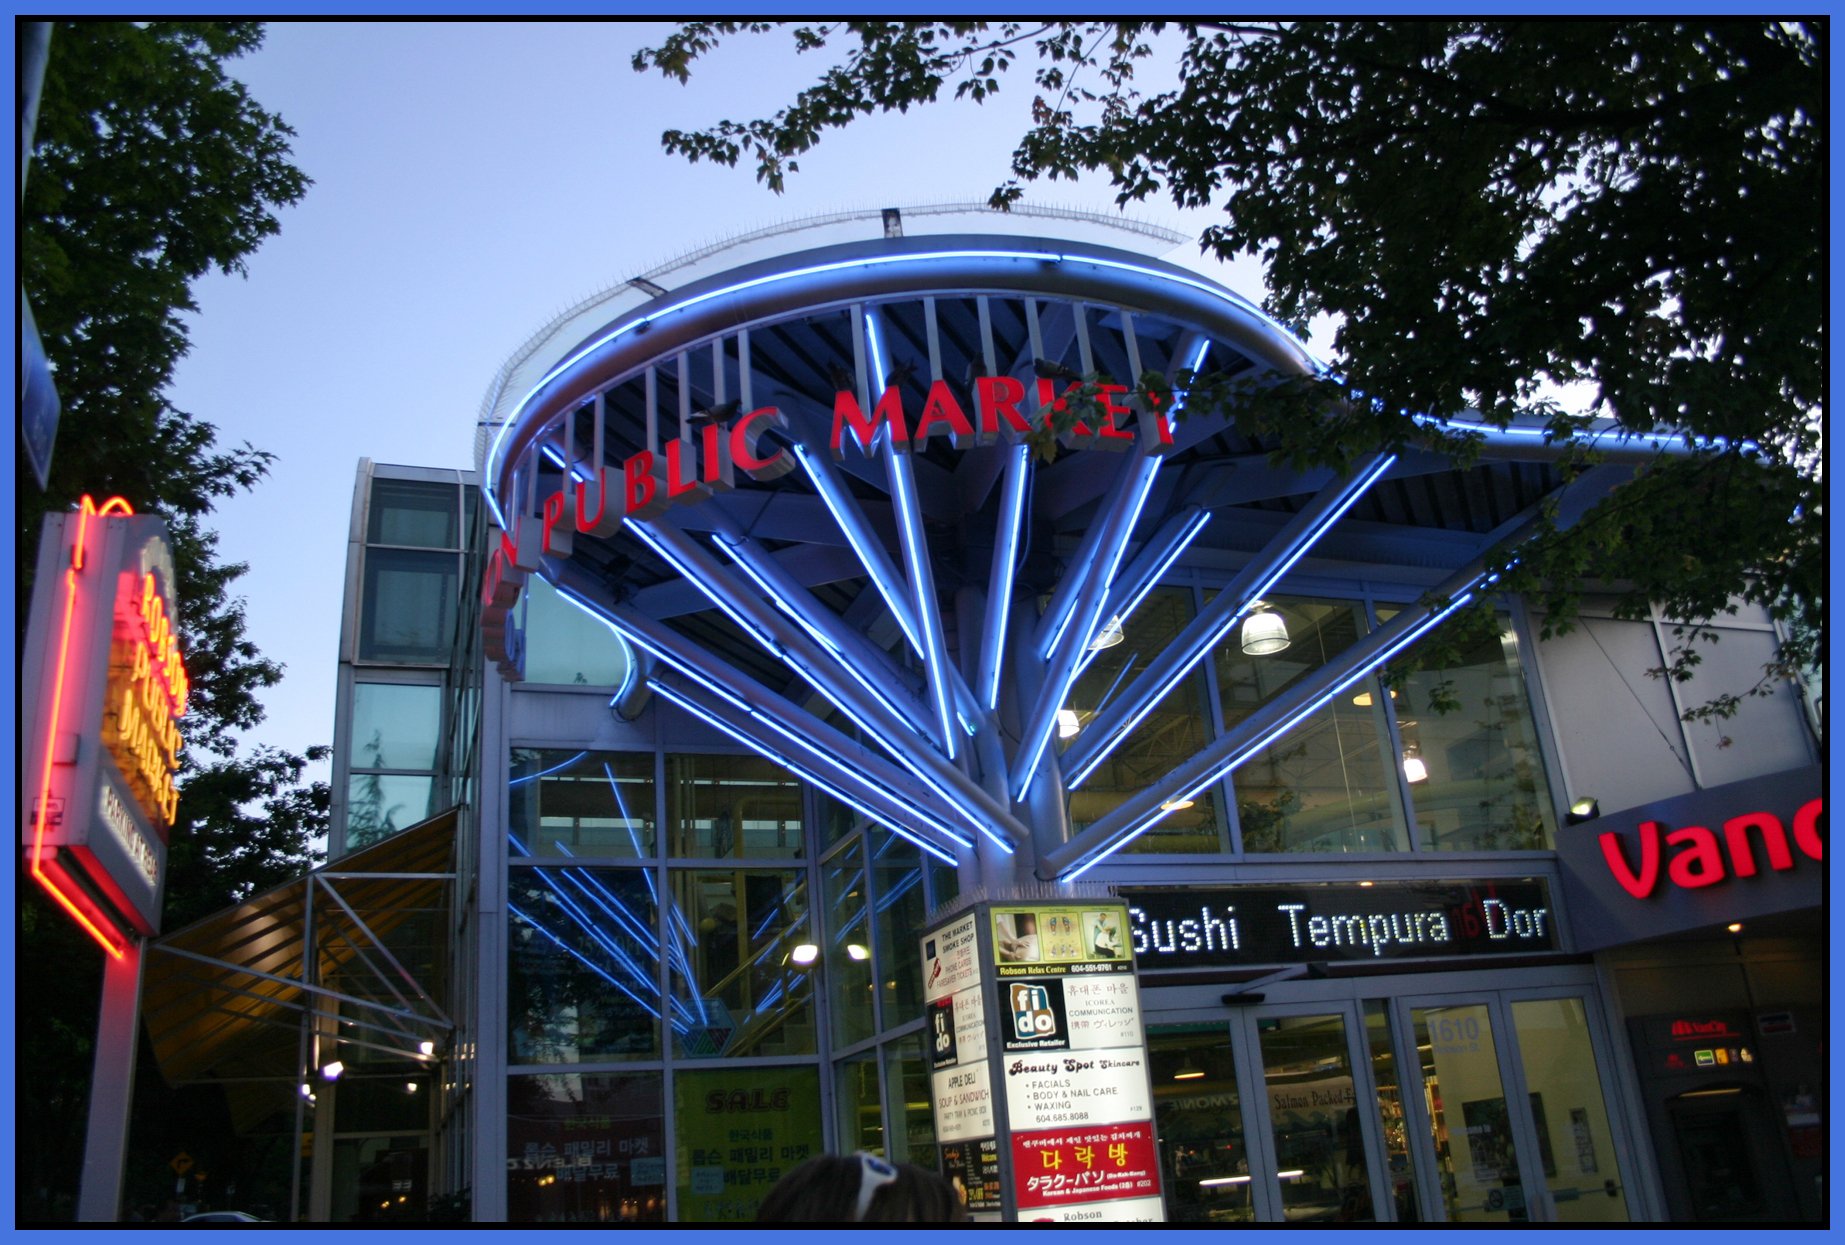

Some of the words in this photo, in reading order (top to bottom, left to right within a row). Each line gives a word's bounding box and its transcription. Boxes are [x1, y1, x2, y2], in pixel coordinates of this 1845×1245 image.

[542, 405, 792, 557] PUBLIC
[133, 641, 182, 769] PUBLIC
[119, 689, 178, 827] MARKET
[942, 932, 952, 943] THE
[952, 920, 974, 936] MARKET
[1129, 904, 1240, 954] Sushi
[1277, 903, 1451, 957] Tempura
[1482, 899, 1549, 939] Dor
[943, 940, 960, 954] SMOKE
[960, 932, 975, 945] SHOP
[1000, 966, 1027, 976] Robson
[1028, 966, 1045, 975] Relax
[1045, 965, 1067, 974] Centre
[1067, 983, 1102, 996] 휴대폰
[1106, 982, 1129, 995] 마을
[1068, 1007, 1134, 1017] COMMUNICATION
[1429, 1016, 1480, 1042] 1610
[1007, 1040, 1039, 1049] Exclusive
[1039, 1039, 1066, 1048] Retailer
[1009, 1059, 1059, 1077] Beauty
[1062, 1058, 1095, 1073] Spot
[1098, 1059, 1141, 1070] Skincare
[948, 1075, 963, 1090] APPLE
[964, 1071, 976, 1086] DELI
[1031, 1079, 1072, 1089] FACIALS
[705, 1087, 792, 1114] SALE
[939, 1095, 952, 1110] SOUP
[959, 1087, 990, 1105] SANDWICH
[1033, 1090, 1060, 1101] BODY
[1061, 1091, 1068, 1099] &
[1070, 1088, 1091, 1098] NAIL
[1092, 1086, 1119, 1097] CARE
[1273, 1093, 1309, 1110] Salmon
[1311, 1088, 1343, 1106] Packed
[1034, 1100, 1072, 1111] WAXING
[1035, 1111, 1090, 1123] 604.685.8088
[1042, 1190, 1065, 1198] Korean
[1072, 1186, 1100, 1195] Japanese
[1101, 1183, 1119, 1191] Foods
[1063, 1212, 1103, 1222] Robson
